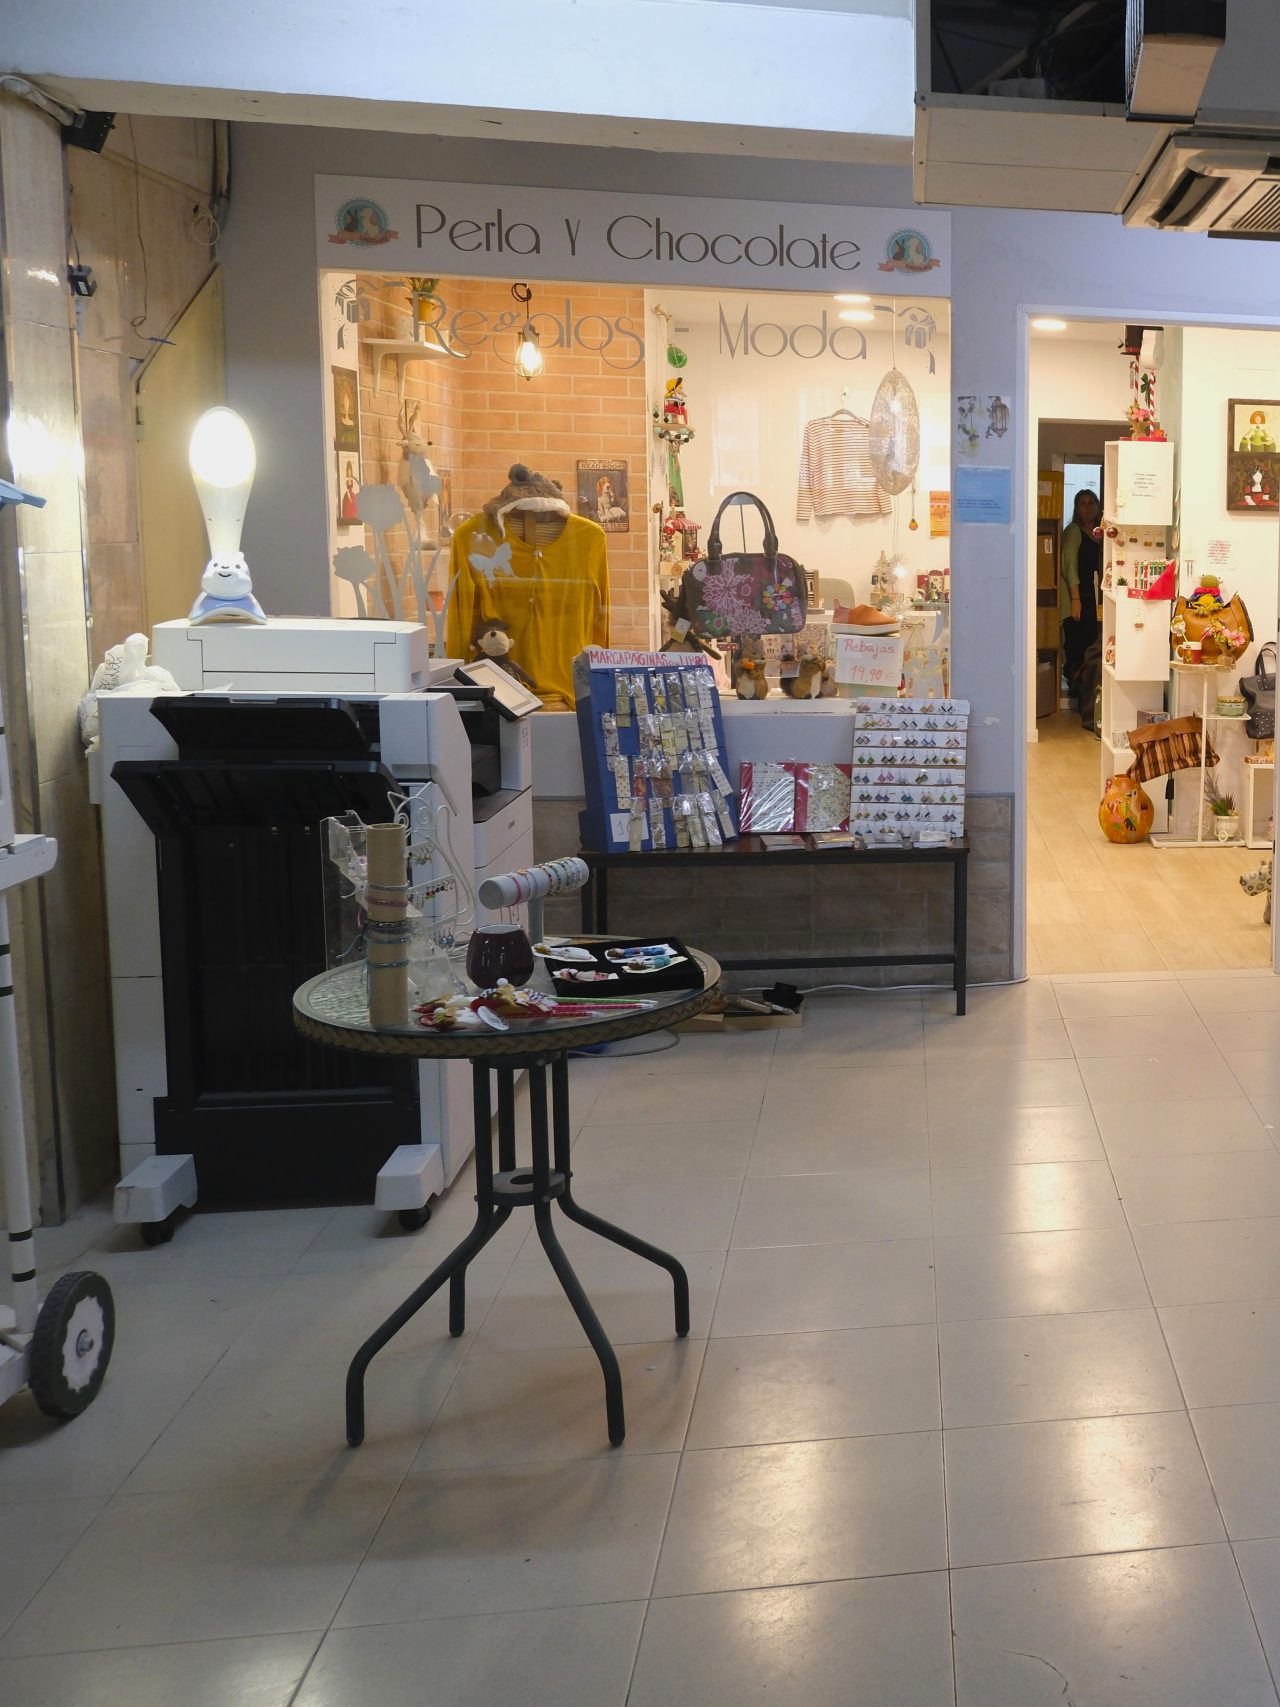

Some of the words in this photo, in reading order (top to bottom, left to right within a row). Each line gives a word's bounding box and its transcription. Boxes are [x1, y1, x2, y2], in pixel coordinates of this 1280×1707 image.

[414, 203, 541, 256] Perla
[606, 215, 861, 272] Chocolate
[412, 291, 646, 370] Regalos
[718, 300, 867, 361] Moda
[844, 638, 895, 660] Rebajas
